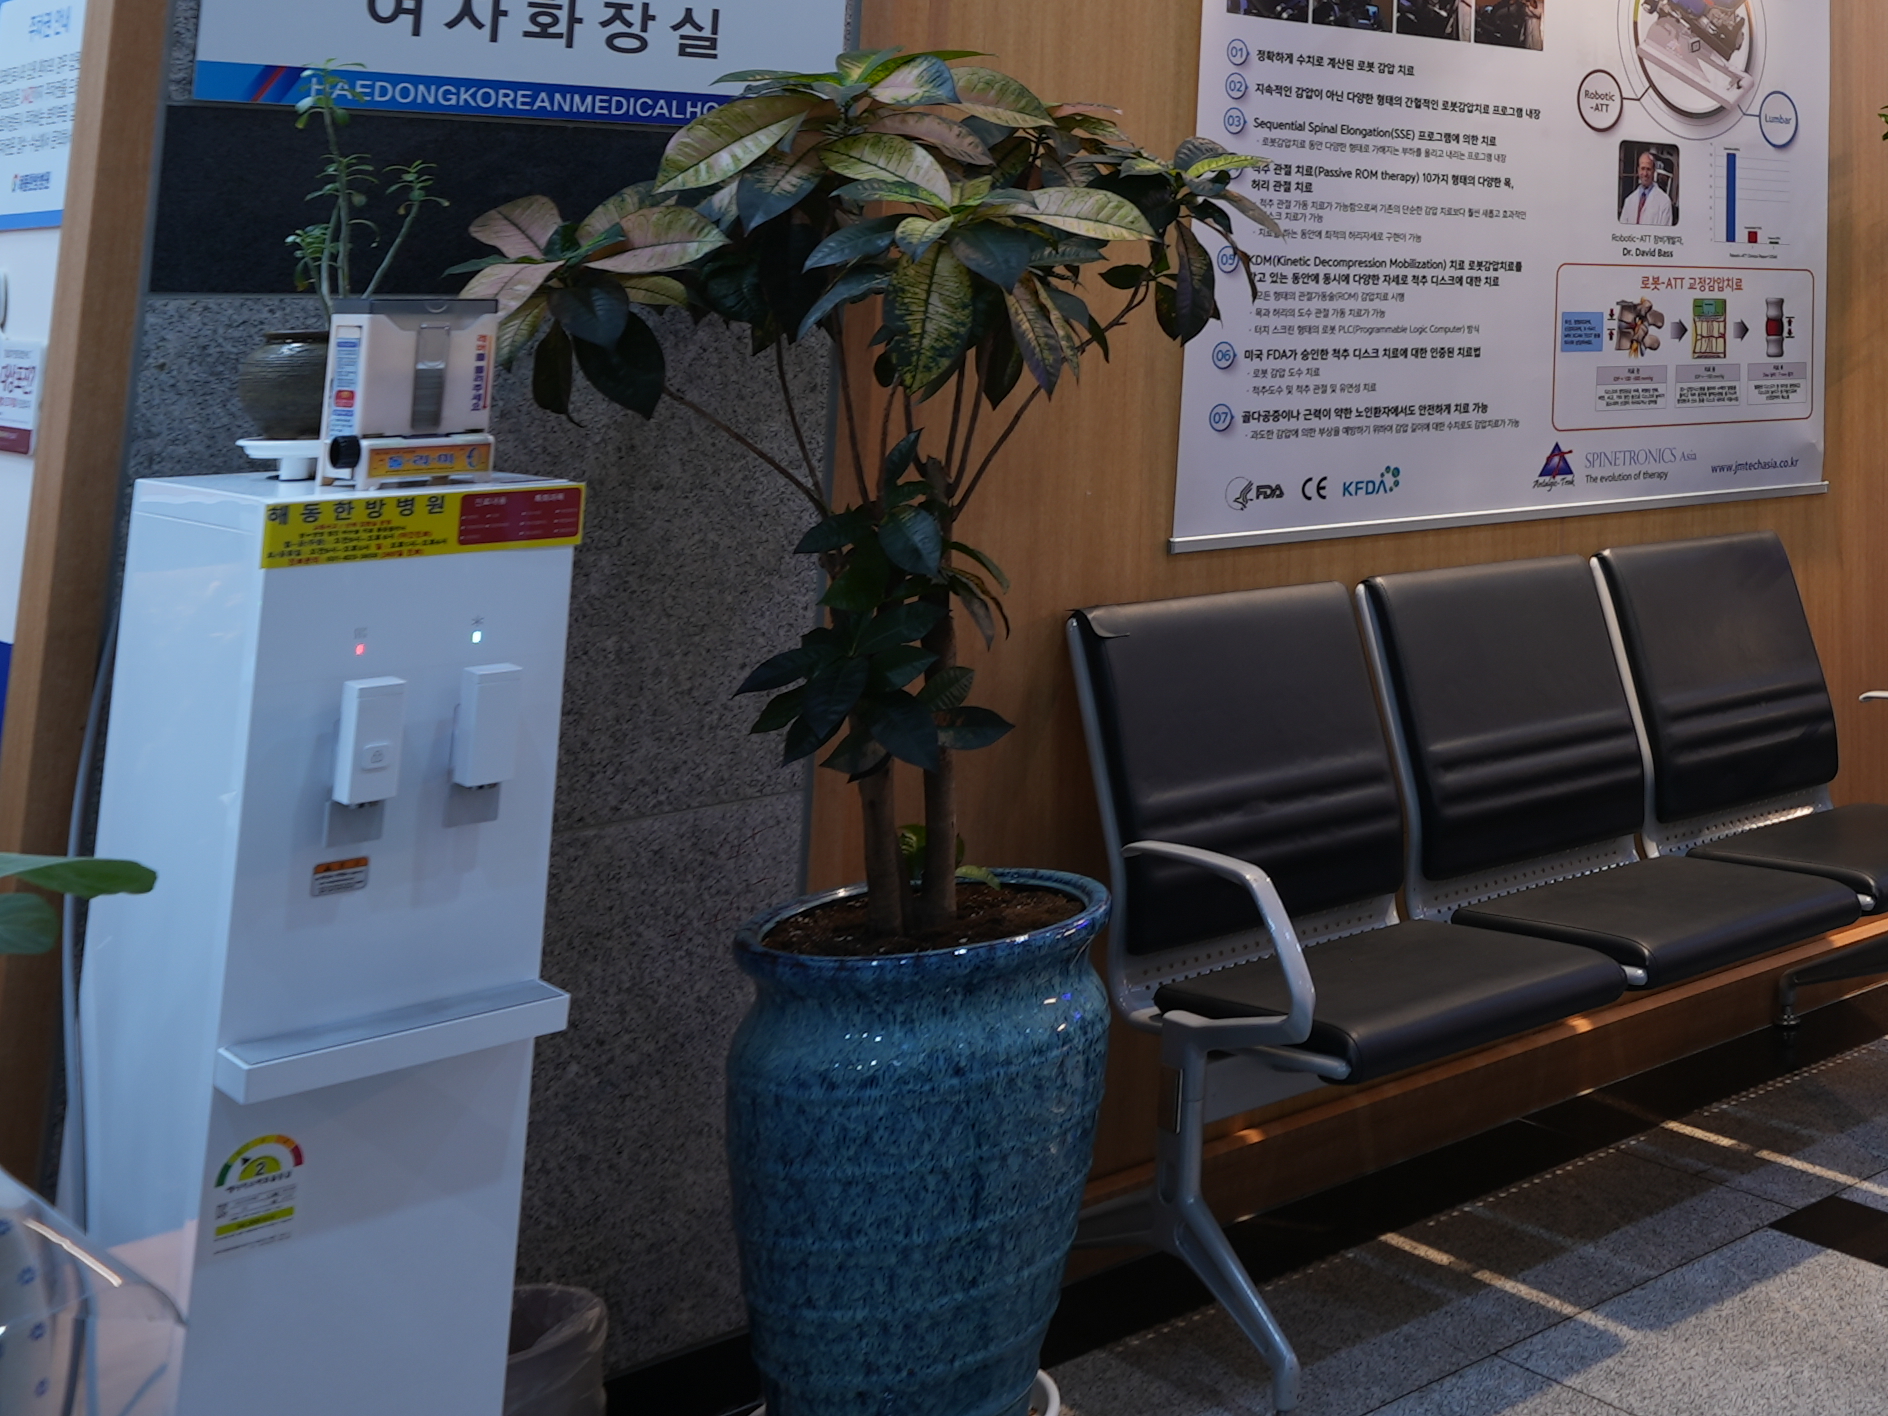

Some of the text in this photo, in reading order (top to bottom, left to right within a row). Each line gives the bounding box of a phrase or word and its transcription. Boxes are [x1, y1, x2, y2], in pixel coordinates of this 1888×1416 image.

[1230, 46, 1416, 76] 01 정확하게 수치로 계산된 로봇 감압 치료
[1229, 80, 1243, 92] 02
[1255, 83, 1292, 98] 지속적인
[1295, 86, 1323, 100] 감압이
[1326, 90, 1344, 102] 아닌
[1346, 92, 1374, 105] 다양한
[1376, 94, 1402, 108] 형태의
[1441, 100, 1490, 114] 로봇감압치료
[1492, 104, 1523, 118] 프로그램
[1526, 108, 1541, 120] 내장
[1585, 90, 1615, 101] Robotic
[1590, 103, 1609, 113] -ATT
[1765, 114, 1792, 125] Lumbar
[1228, 115, 1497, 146] 03 Sequential Spinal Elongation(SSE) 프로그램에 의한 치료
[1251, 178, 1314, 193] 허리 관절 치료
[1622, 248, 1674, 258] Dr. David Bass
[1250, 255, 1310, 268] KDM(Kinetic
[1314, 256, 1386, 270] Decompression
[1450, 260, 1465, 271] 치료
[1640, 276, 1744, 292] 로봇-ATT 교정감압치료
[1216, 346, 1481, 362] 06 미국 FDA가 승인한 척추 디스크 치료에 대한 인증된 치료법
[1214, 402, 1488, 424] 07 골다공증이나 근력이 약한 노인환자에서도 안전하게 치료 가능
[1585, 447, 1676, 469] SPINETRONICS
[1585, 470, 1669, 484] The evolution of therapy
[1256, 484, 1284, 500] FDA
[1302, 476, 1327, 501] CE
[1342, 479, 1388, 497] KFDA
[268, 495, 445, 525] 해동한방병원
[254, 1162, 265, 1176] 2
